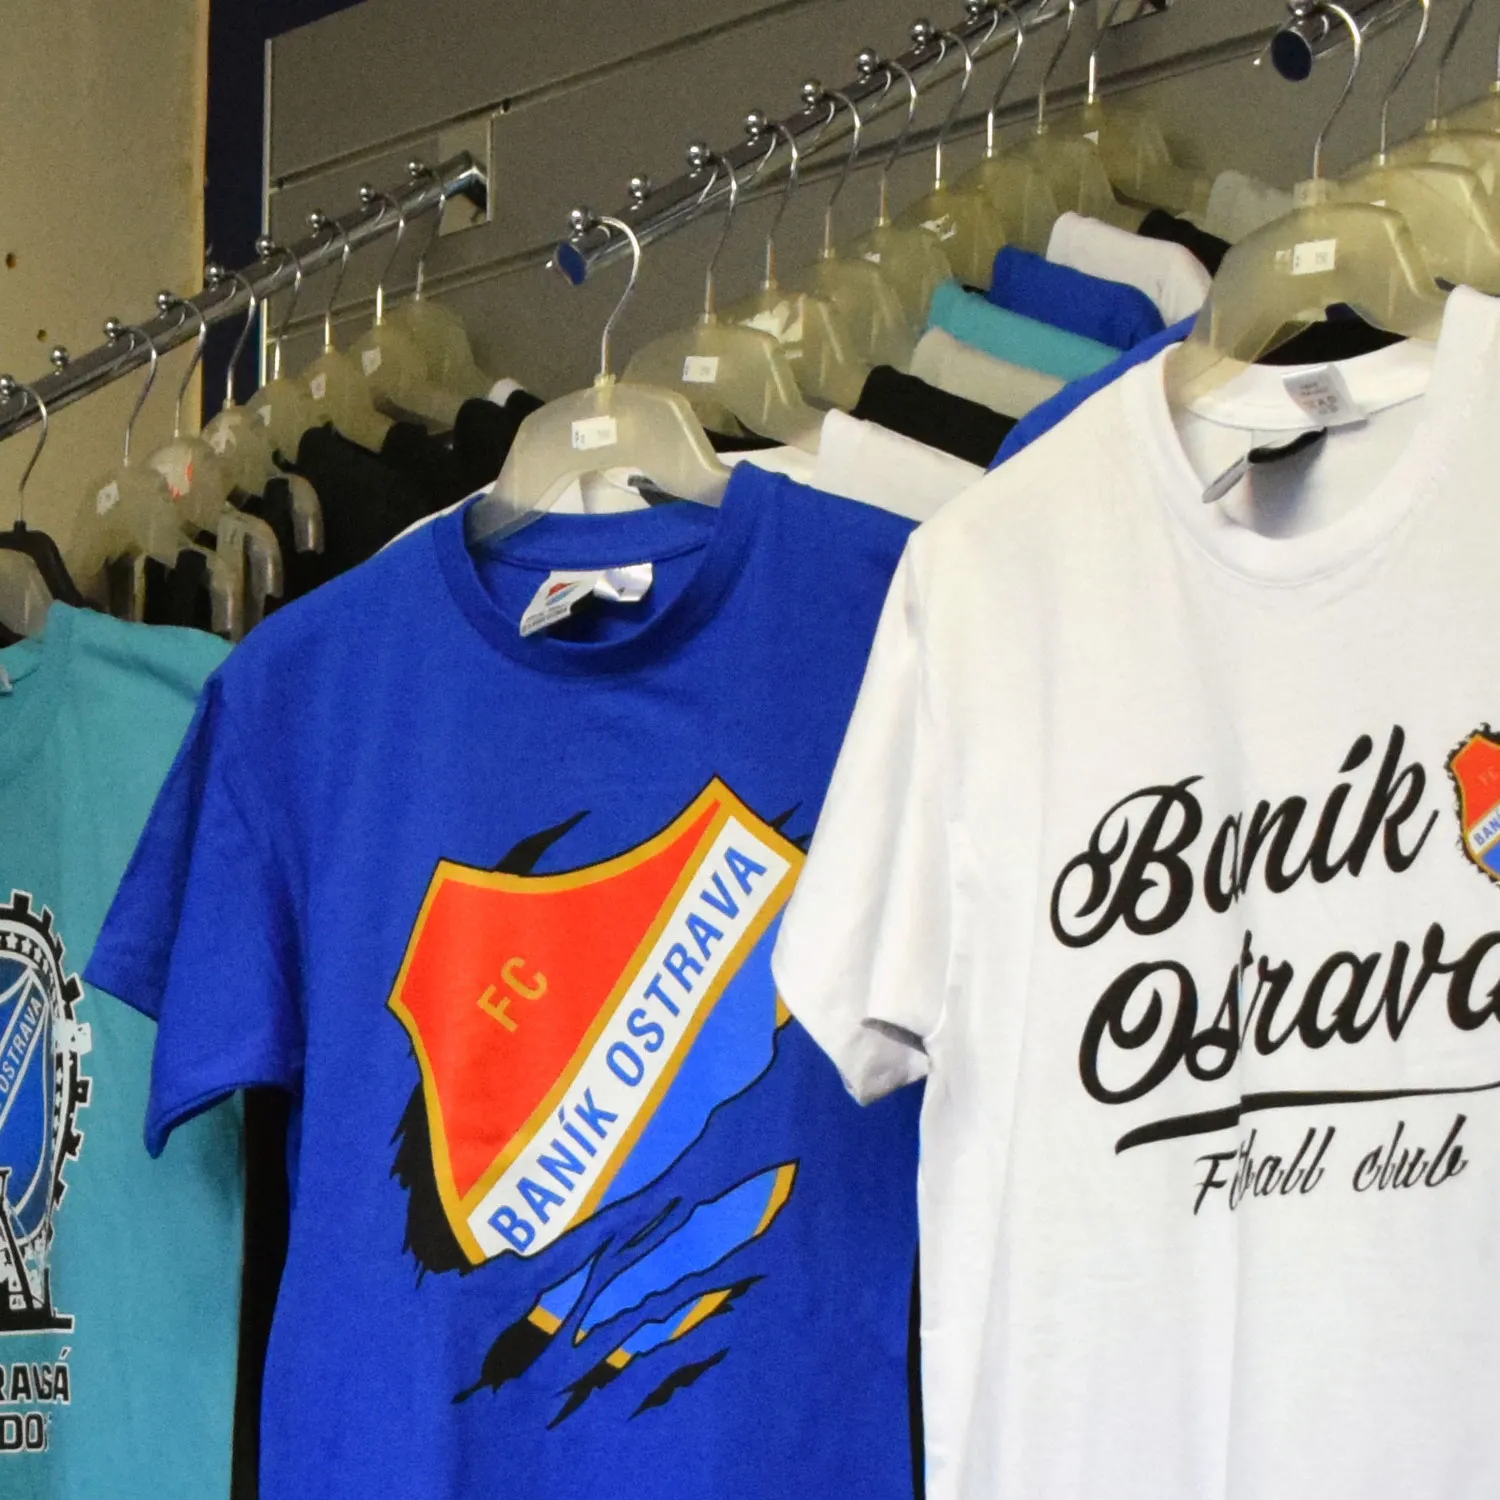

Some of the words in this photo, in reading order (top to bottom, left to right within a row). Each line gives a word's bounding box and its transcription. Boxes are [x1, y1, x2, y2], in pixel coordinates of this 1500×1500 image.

[1477, 765, 1500, 786] FC
[1050, 724, 1440, 948] Baník
[477, 955, 549, 1033] FC
[488, 1088, 619, 1254] BANÍK
[605, 845, 767, 1088] OSTRAVA
[1353, 1114, 1468, 1192] club
